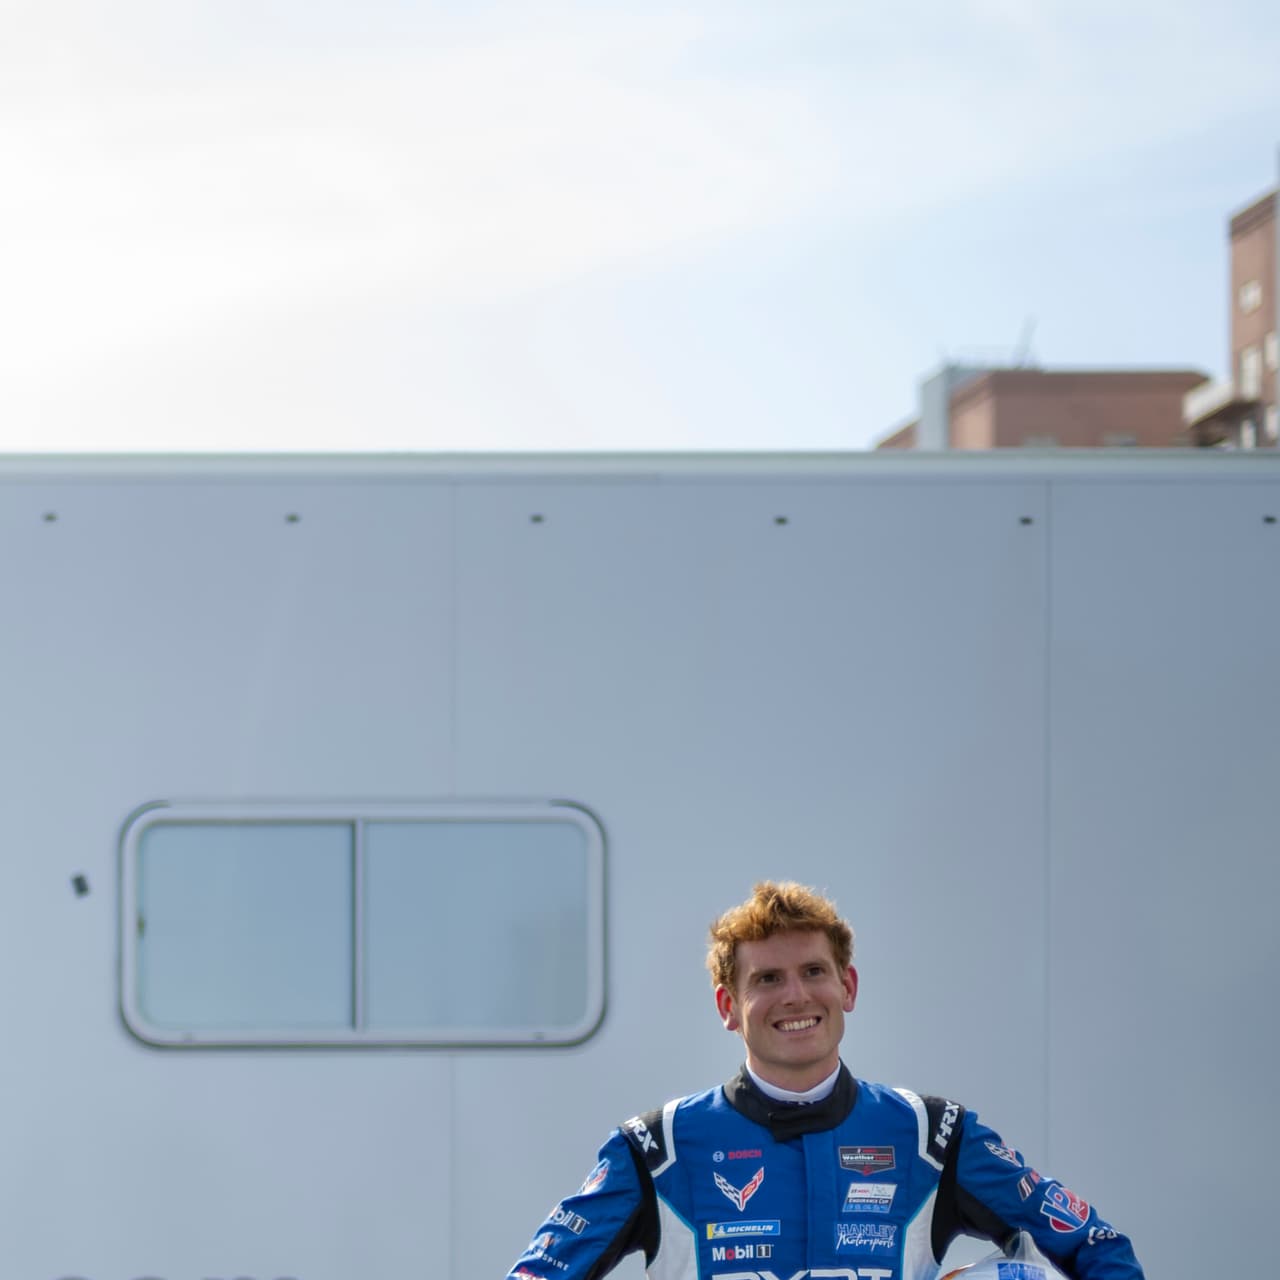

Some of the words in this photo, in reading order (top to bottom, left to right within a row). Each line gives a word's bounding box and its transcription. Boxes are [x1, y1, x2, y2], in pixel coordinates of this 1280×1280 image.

[934, 1100, 961, 1149] HRX
[727, 1149, 762, 1160] BOSCH
[726, 1224, 774, 1233] MICHELIN
[837, 1223, 898, 1237] HANLEY
[836, 1234, 895, 1252] Motorsports
[712, 1244, 754, 1262] Mobil
